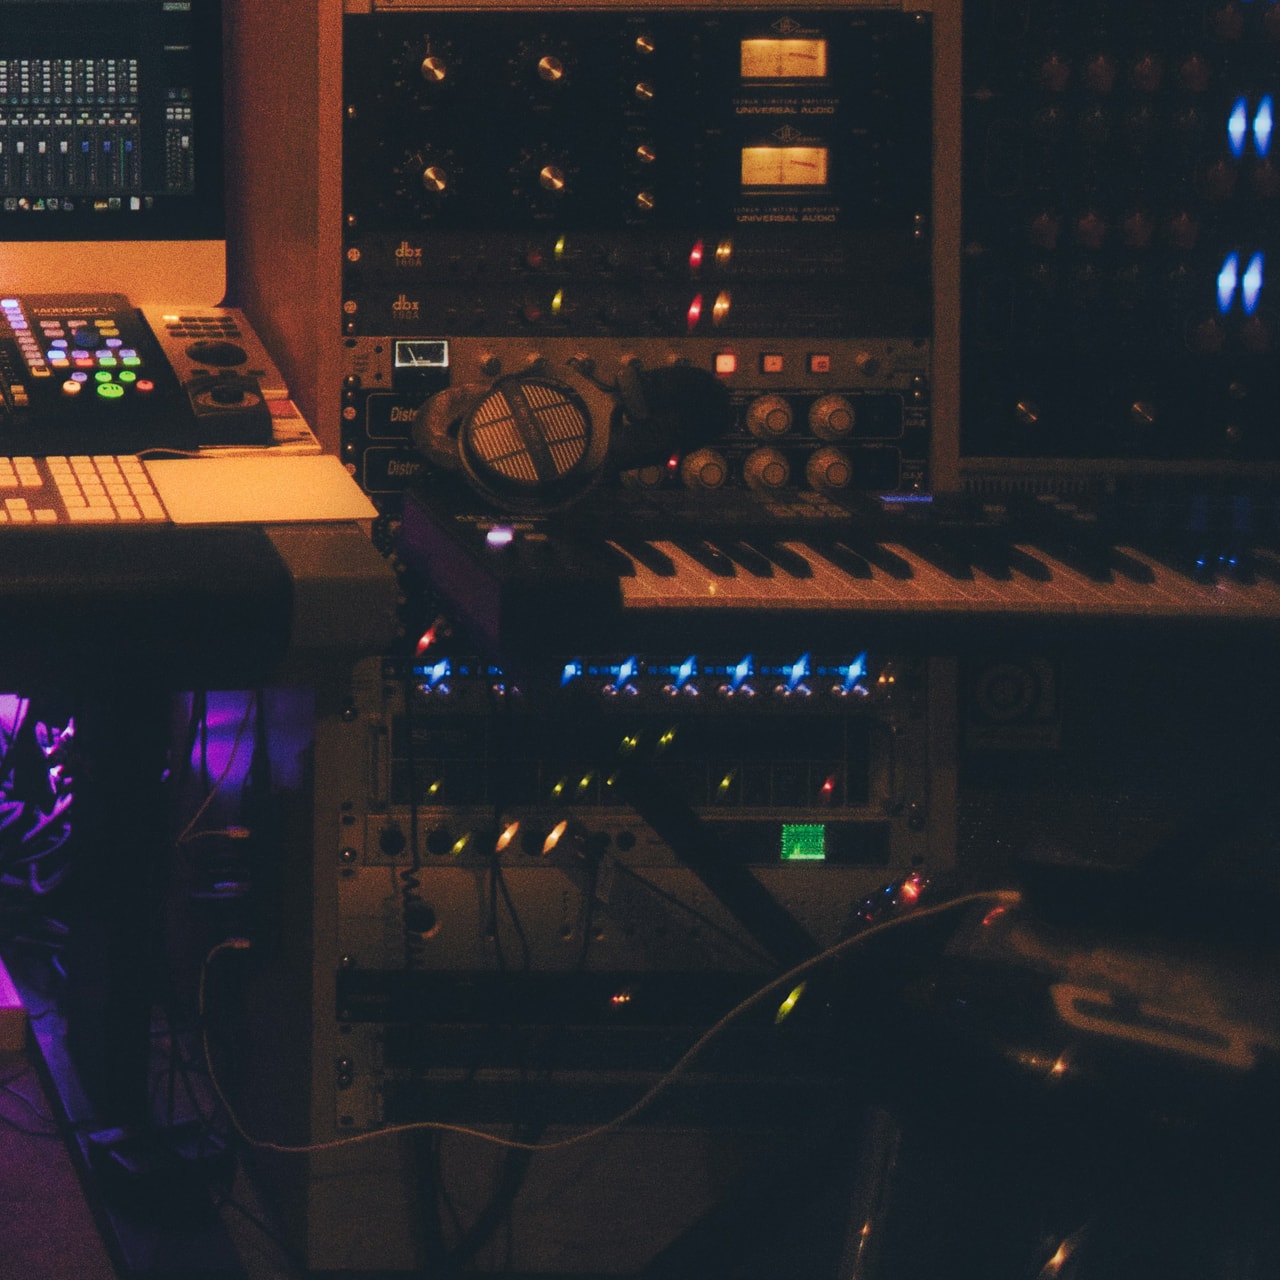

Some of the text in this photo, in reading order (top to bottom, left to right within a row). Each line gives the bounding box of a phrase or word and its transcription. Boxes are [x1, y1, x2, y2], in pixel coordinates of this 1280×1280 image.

[736, 214, 836, 222] UNIVERSAL AUDIO
[395, 240, 423, 257] dbx
[392, 293, 420, 310] dbx
[390, 406, 418, 422] Distr
[387, 460, 419, 475] Distr
